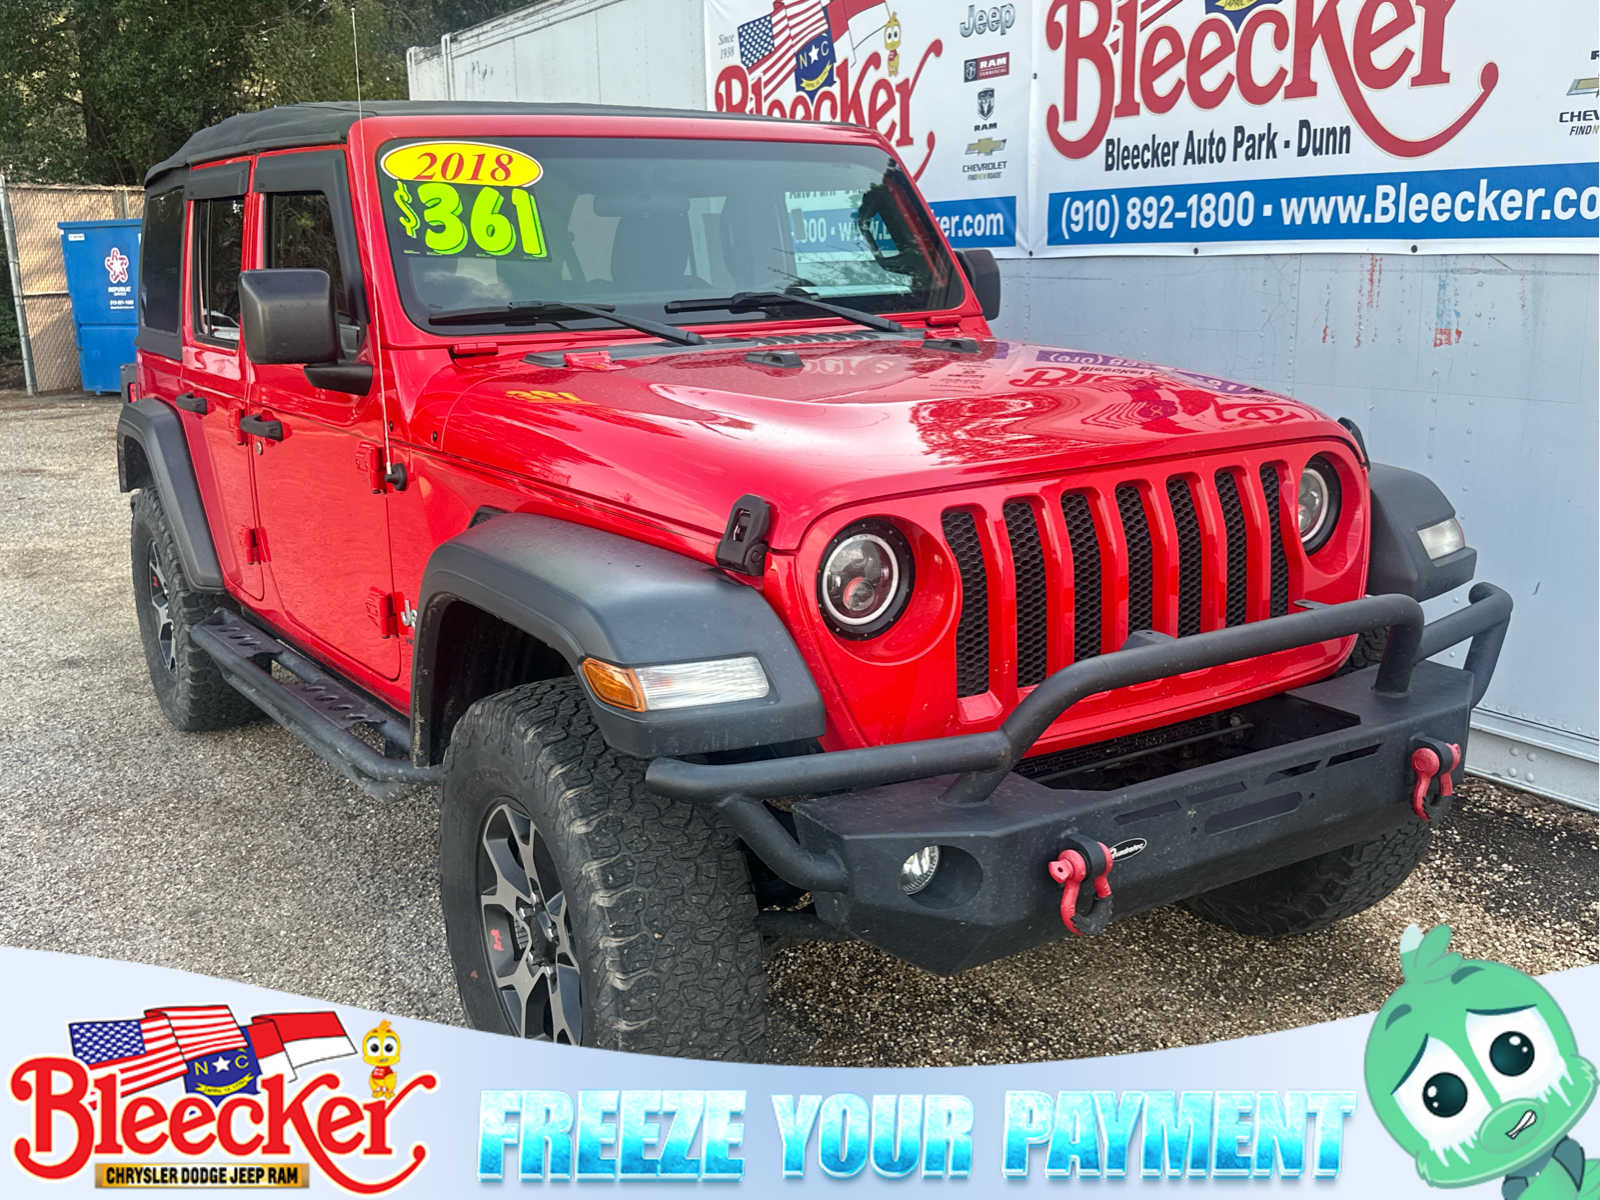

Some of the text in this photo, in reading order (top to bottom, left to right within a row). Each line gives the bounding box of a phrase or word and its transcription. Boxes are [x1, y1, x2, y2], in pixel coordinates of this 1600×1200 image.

[960, 2, 1016, 37] Jeep
[980, 56, 1007, 69] RAM
[1046, 0, 1499, 158] Bleecker
[974, 122, 998, 132] RAM
[1104, 120, 1351, 172] Bleecker Auto Park Dunn
[414, 152, 514, 183] 2018
[962, 160, 1008, 173] CHEVROLET
[393, 179, 548, 258] $361
[1061, 193, 1120, 240] (910)
[1126, 189, 1255, 231] 892-1800
